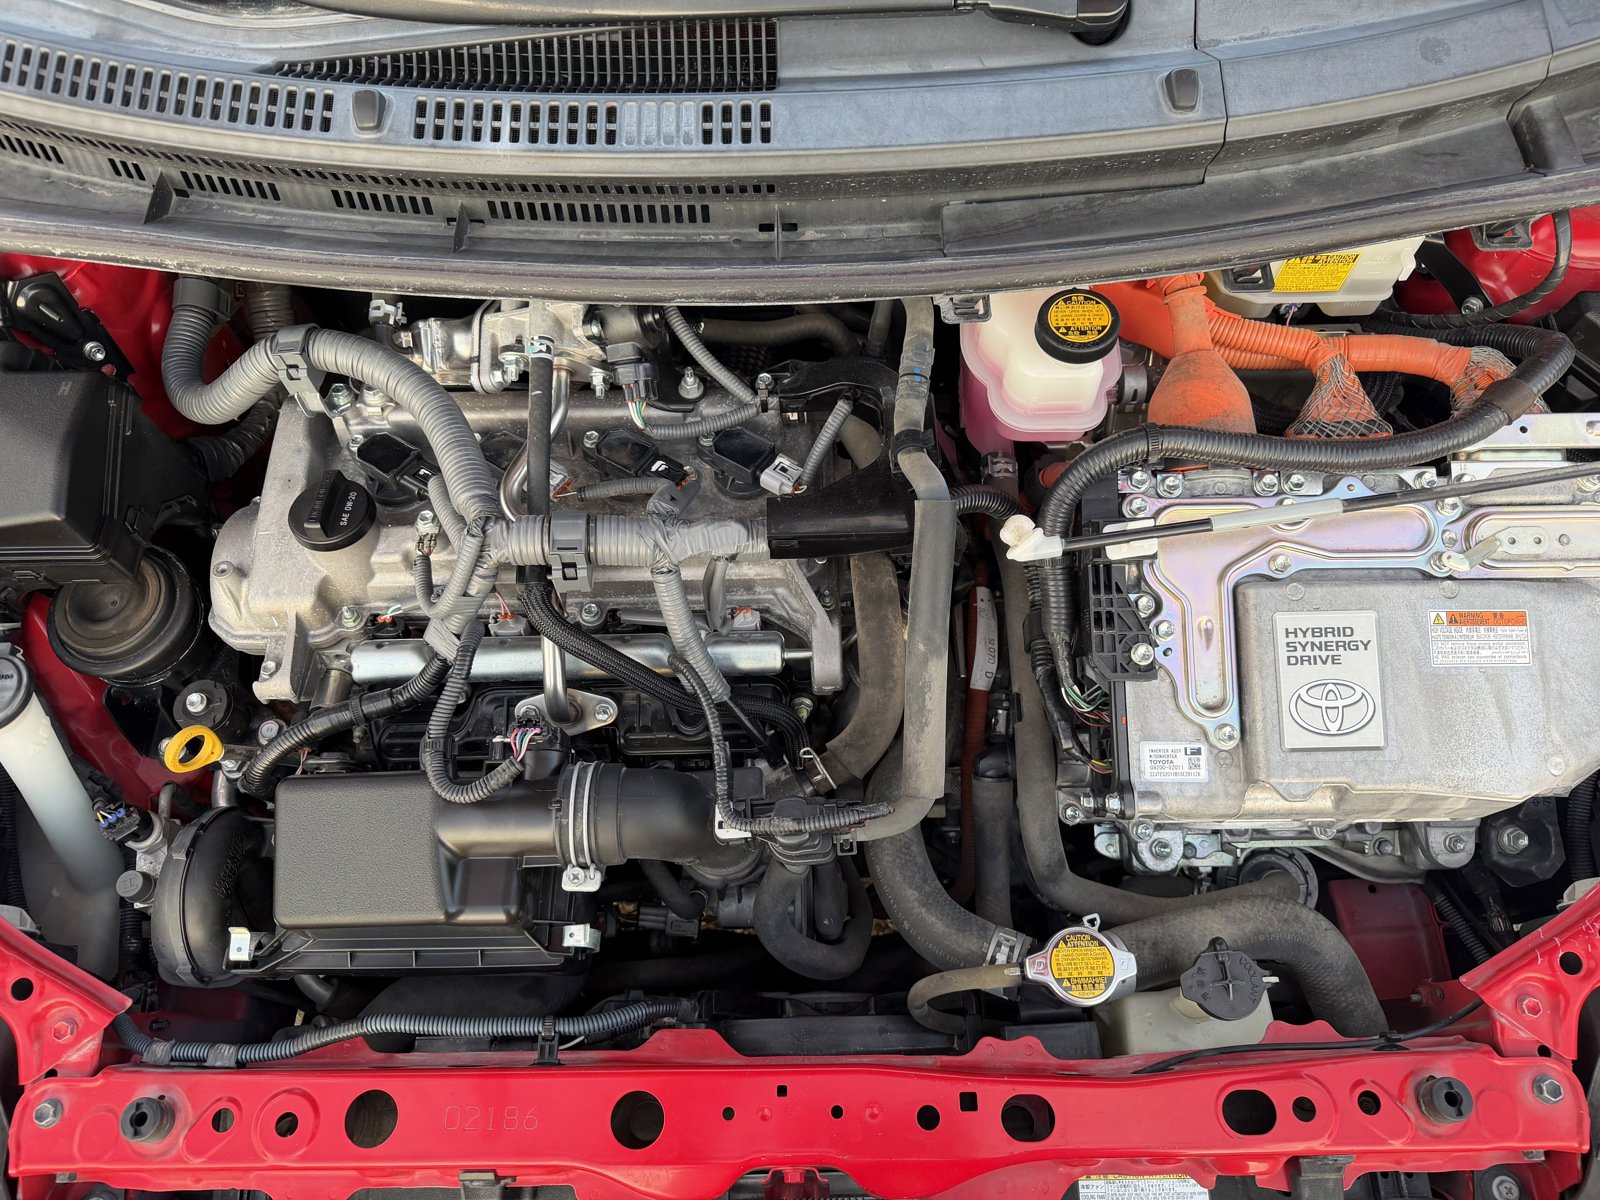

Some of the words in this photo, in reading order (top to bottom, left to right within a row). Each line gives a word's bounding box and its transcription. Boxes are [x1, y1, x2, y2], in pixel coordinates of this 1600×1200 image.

[344, 491, 357, 511] 0W-20
[340, 513, 350, 526] SAE
[1285, 627, 1354, 638] HYBRID
[1286, 640, 1371, 652] SYNERGY
[1287, 655, 1342, 665] DRIVE
[1240, 956, 1259, 1004] COOLANT
[444, 1105, 538, 1131] 02186
